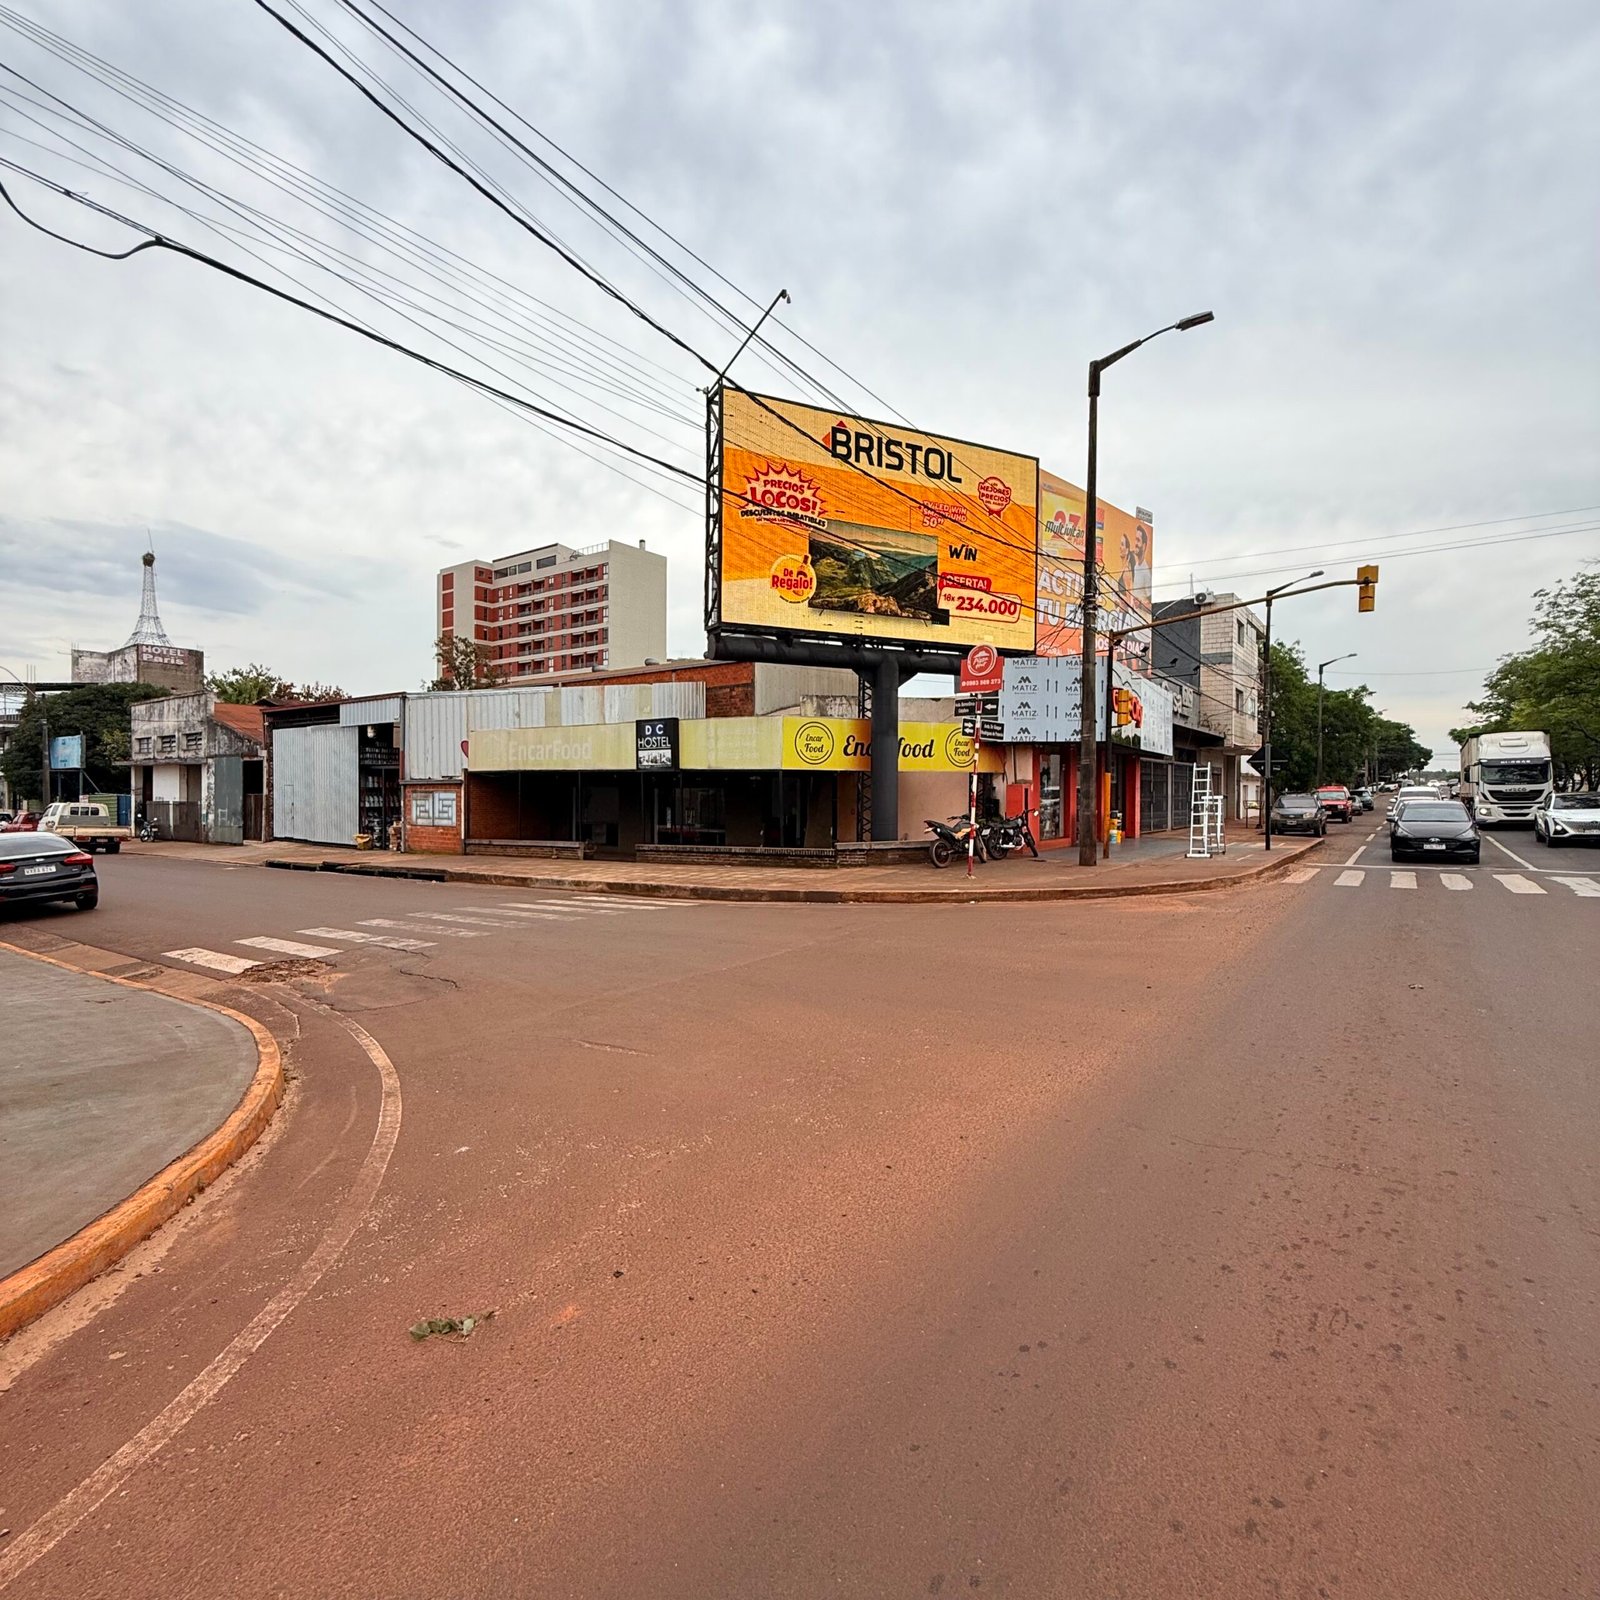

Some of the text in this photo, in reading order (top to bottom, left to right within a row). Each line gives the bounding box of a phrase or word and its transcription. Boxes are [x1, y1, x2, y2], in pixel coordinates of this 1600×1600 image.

[831, 426, 962, 483] BRISTOL
[763, 479, 805, 495] PRECIOS
[980, 485, 1009, 496] MEJORES
[750, 487, 818, 515] LOCOS!
[981, 492, 1008, 503] PRECIOS
[951, 506, 967, 515] WIN
[784, 568, 793, 578] De
[772, 575, 813, 590] Regalo!
[956, 596, 1017, 616] 234.000
[1037, 597, 1061, 626] TU
[142, 645, 184, 657] HOTEL
[142, 653, 184, 665] Paris
[1012, 684, 1038, 692] MATIZ
[1011, 710, 1037, 718] MATIZ
[645, 723, 664, 735] D C
[638, 736, 671, 748] HOSTEL
[805, 733, 824, 742] Encar
[954, 738, 971, 747] Encar
[804, 743, 824, 753] Food
[953, 748, 971, 757] Food
